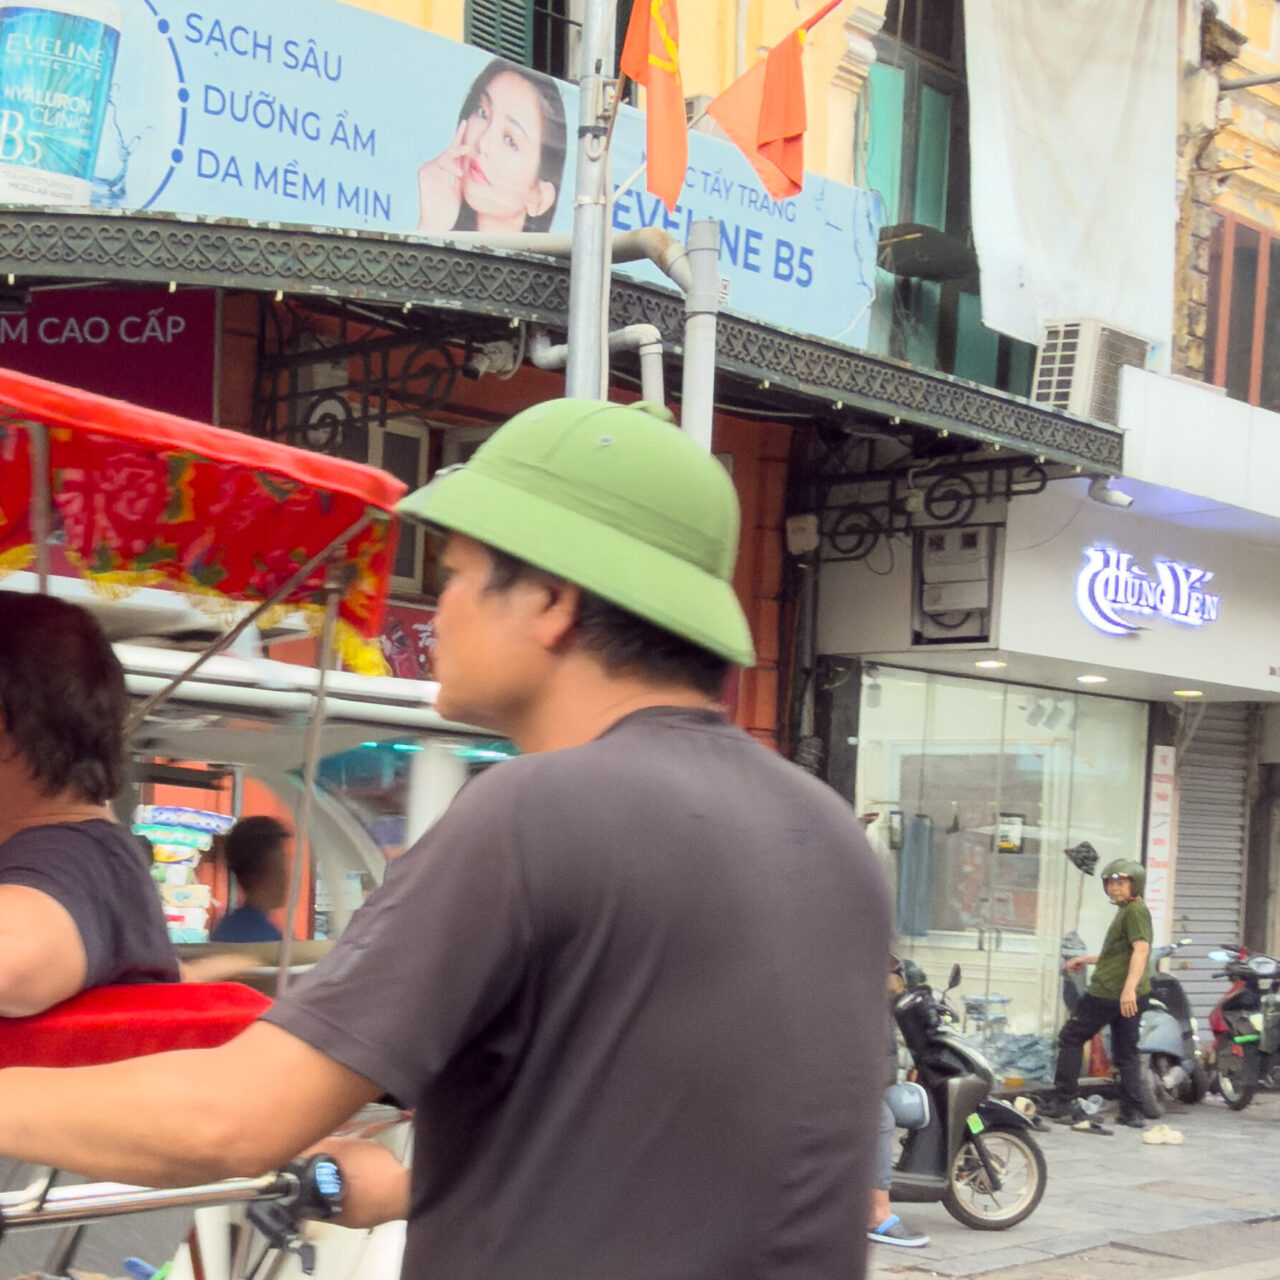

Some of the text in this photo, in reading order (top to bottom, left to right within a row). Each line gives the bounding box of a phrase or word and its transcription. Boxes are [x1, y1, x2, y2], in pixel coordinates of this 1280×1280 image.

[6, 33, 104, 69] EVELINE
[185, 13, 342, 82] SẠCH SÂU
[4, 84, 92, 116] HYALURON
[203, 84, 376, 156] DƯỠNG ẨM
[197, 148, 391, 223] DA MỀM MỊN
[738, 184, 797, 222] TRANG
[612, 184, 814, 288] EVELNE B5
[38, 316, 110, 344] CAO
[119, 307, 186, 343] CẤP
